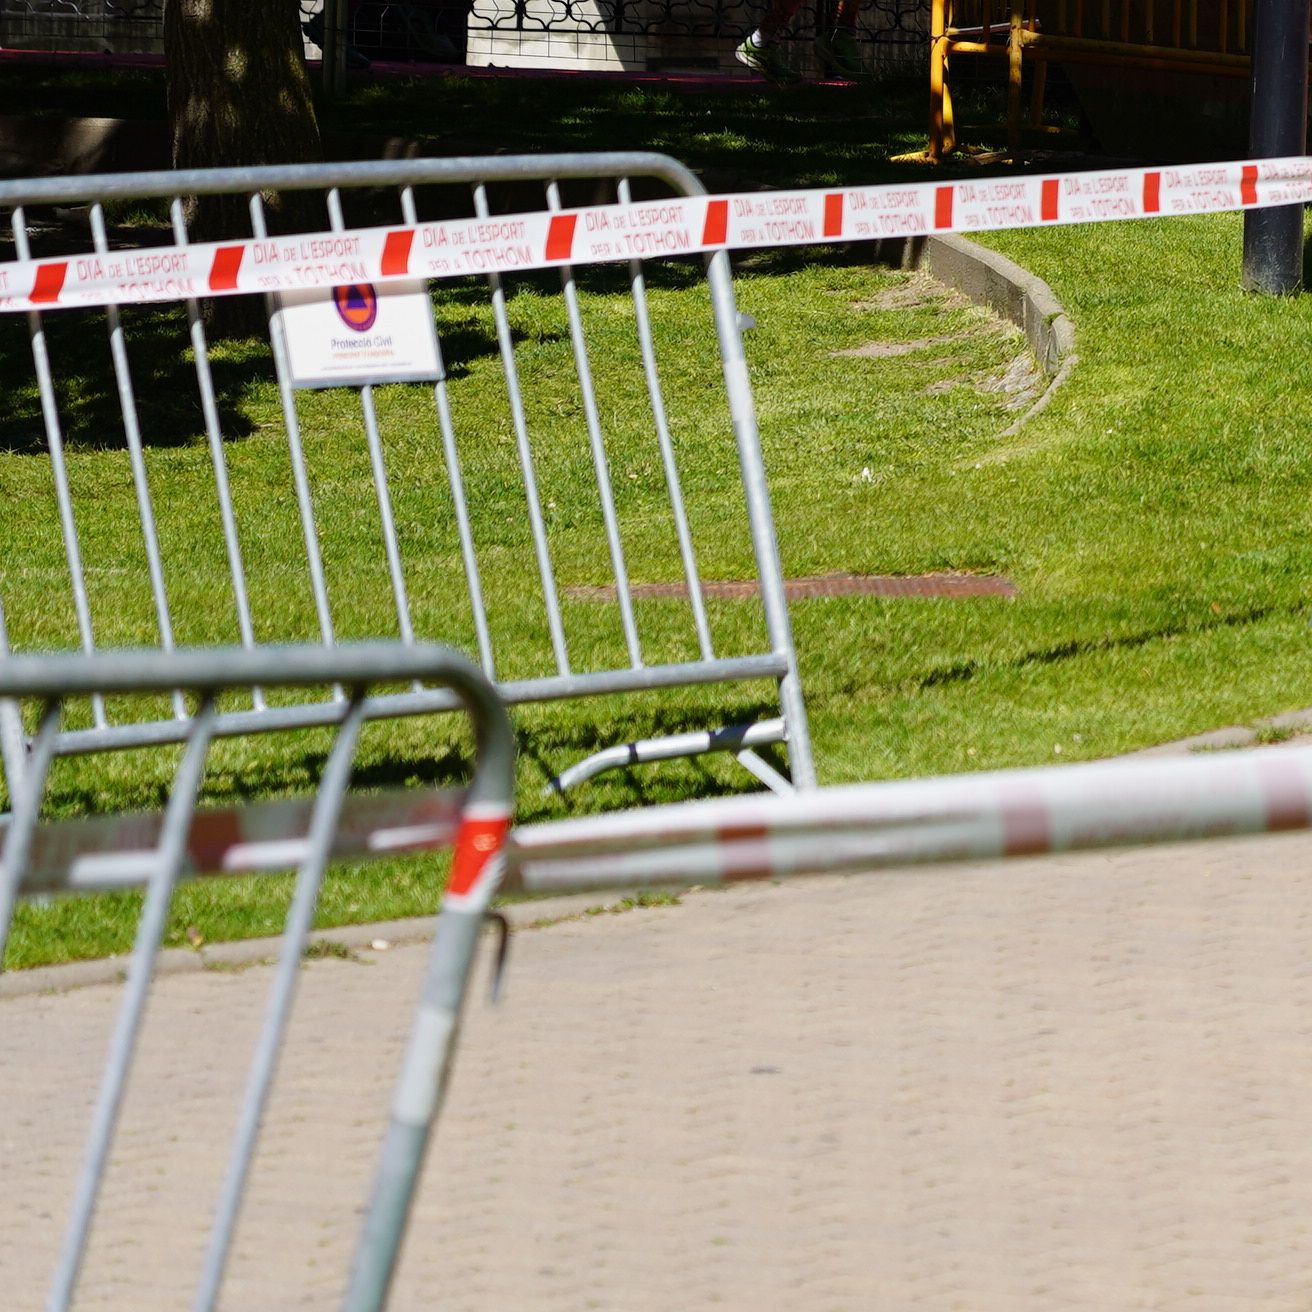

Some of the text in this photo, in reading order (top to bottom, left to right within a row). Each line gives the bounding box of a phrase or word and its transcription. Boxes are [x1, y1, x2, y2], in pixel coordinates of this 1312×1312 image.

[734, 199, 751, 217] DIA
[766, 197, 808, 216] L'ESPORT
[849, 192, 866, 210] DIA
[585, 210, 609, 231] DIA
[628, 206, 684, 227] L'ESPORT
[423, 227, 448, 247] DIA
[467, 221, 526, 243] L'ESPORT
[624, 230, 691, 254] TOTHOM
[253, 242, 279, 264] DIA
[300, 237, 360, 260] L'ESPORT
[462, 246, 533, 268] TOTHOM
[76, 260, 102, 281] DIA
[125, 252, 187, 276] L'ESPORT
[294, 262, 368, 284] TOTHOM
